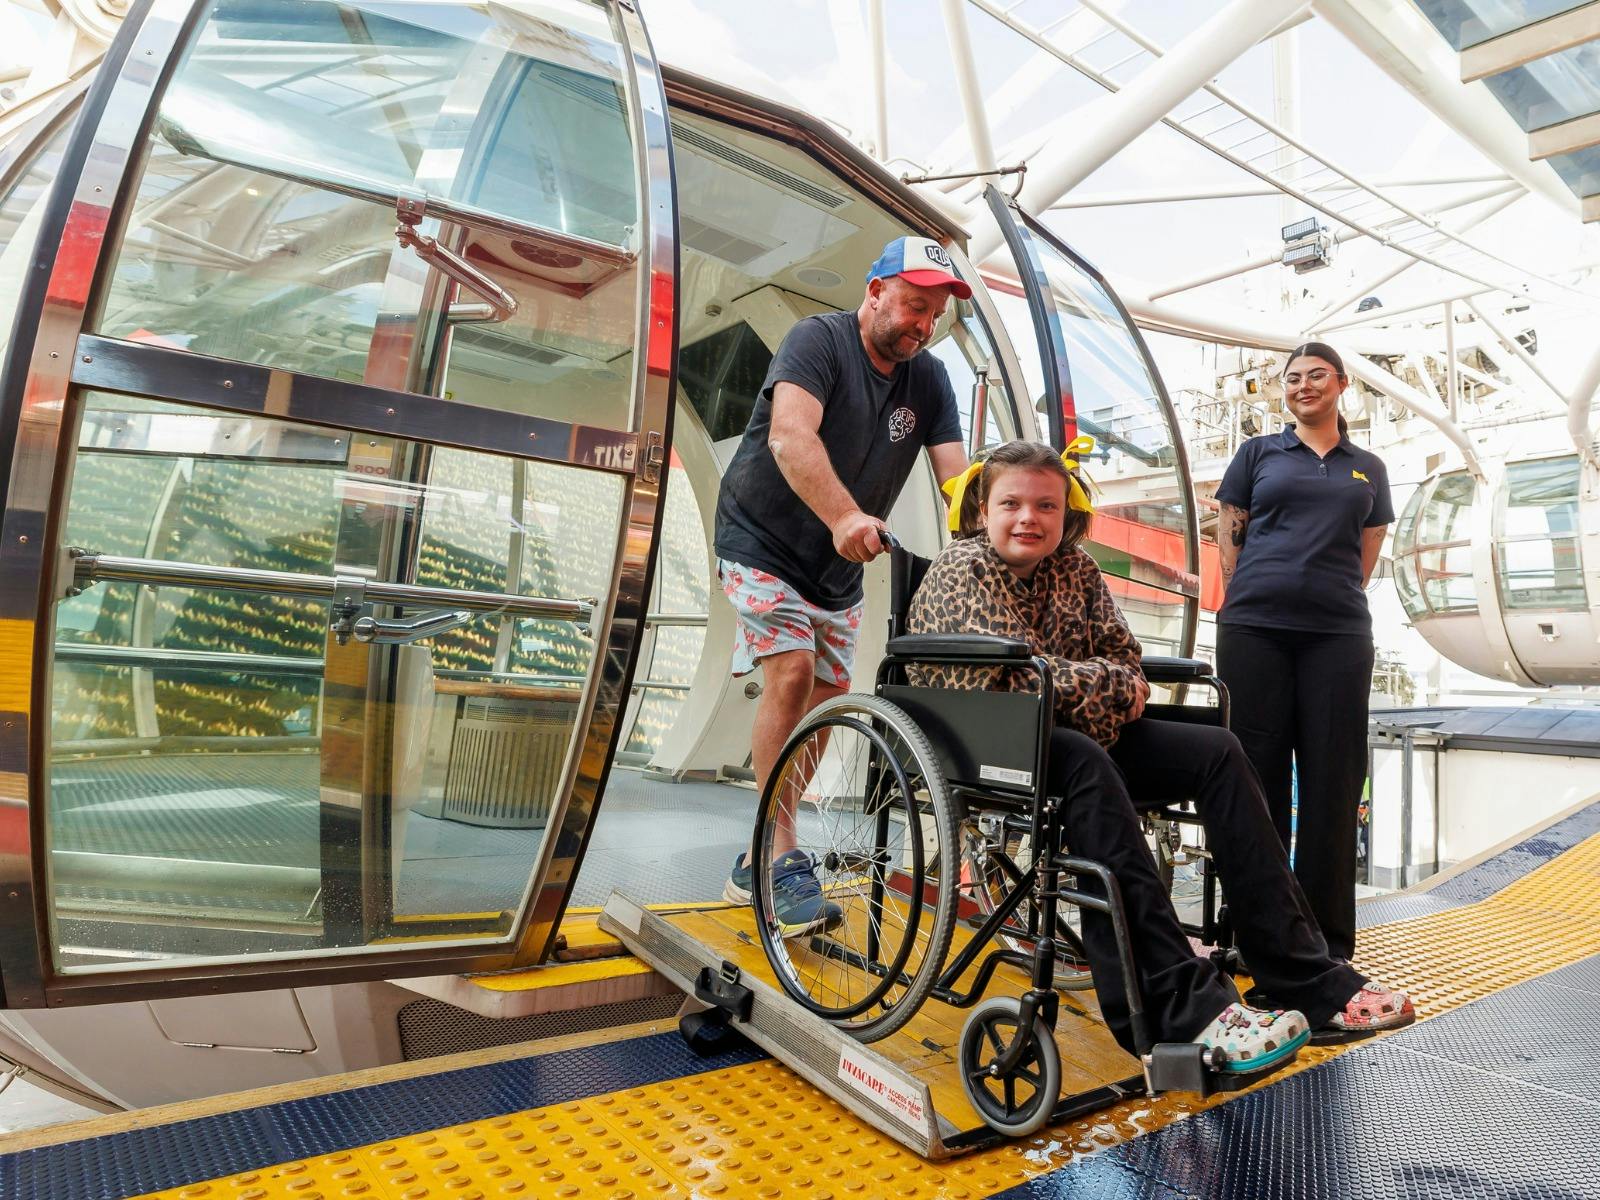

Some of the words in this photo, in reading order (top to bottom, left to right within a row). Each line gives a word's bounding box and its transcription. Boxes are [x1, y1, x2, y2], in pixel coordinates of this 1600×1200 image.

[887, 1096, 907, 1111] CAPACITY
[888, 1088, 907, 1104] ACCESS
[907, 1100, 922, 1113] RAMP
